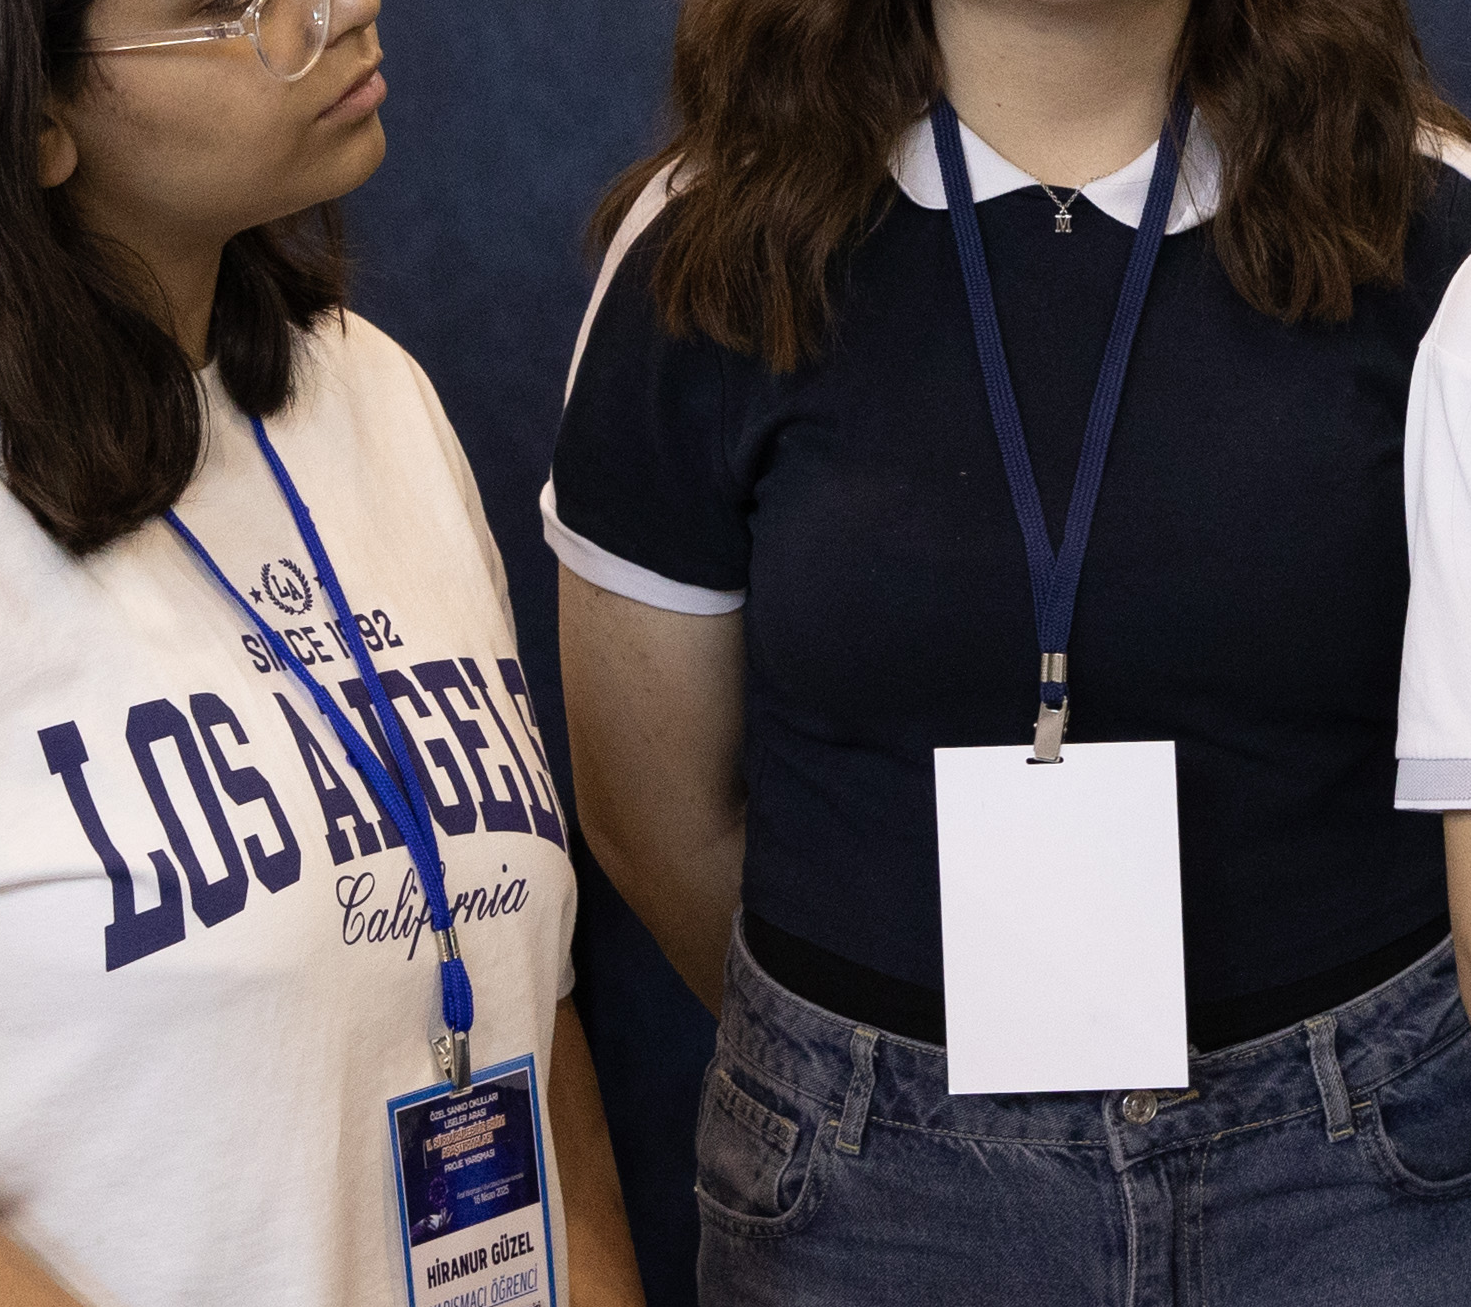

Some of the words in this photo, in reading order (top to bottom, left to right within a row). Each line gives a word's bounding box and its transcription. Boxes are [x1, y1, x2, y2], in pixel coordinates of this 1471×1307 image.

[270, 574, 304, 601] LA
[37, 692, 302, 972] LOS
[427, 1248, 488, 1289] HİRANUR
[491, 1231, 534, 1265] GÜZEL
[491, 1263, 538, 1304] ÖĞRENCİ
